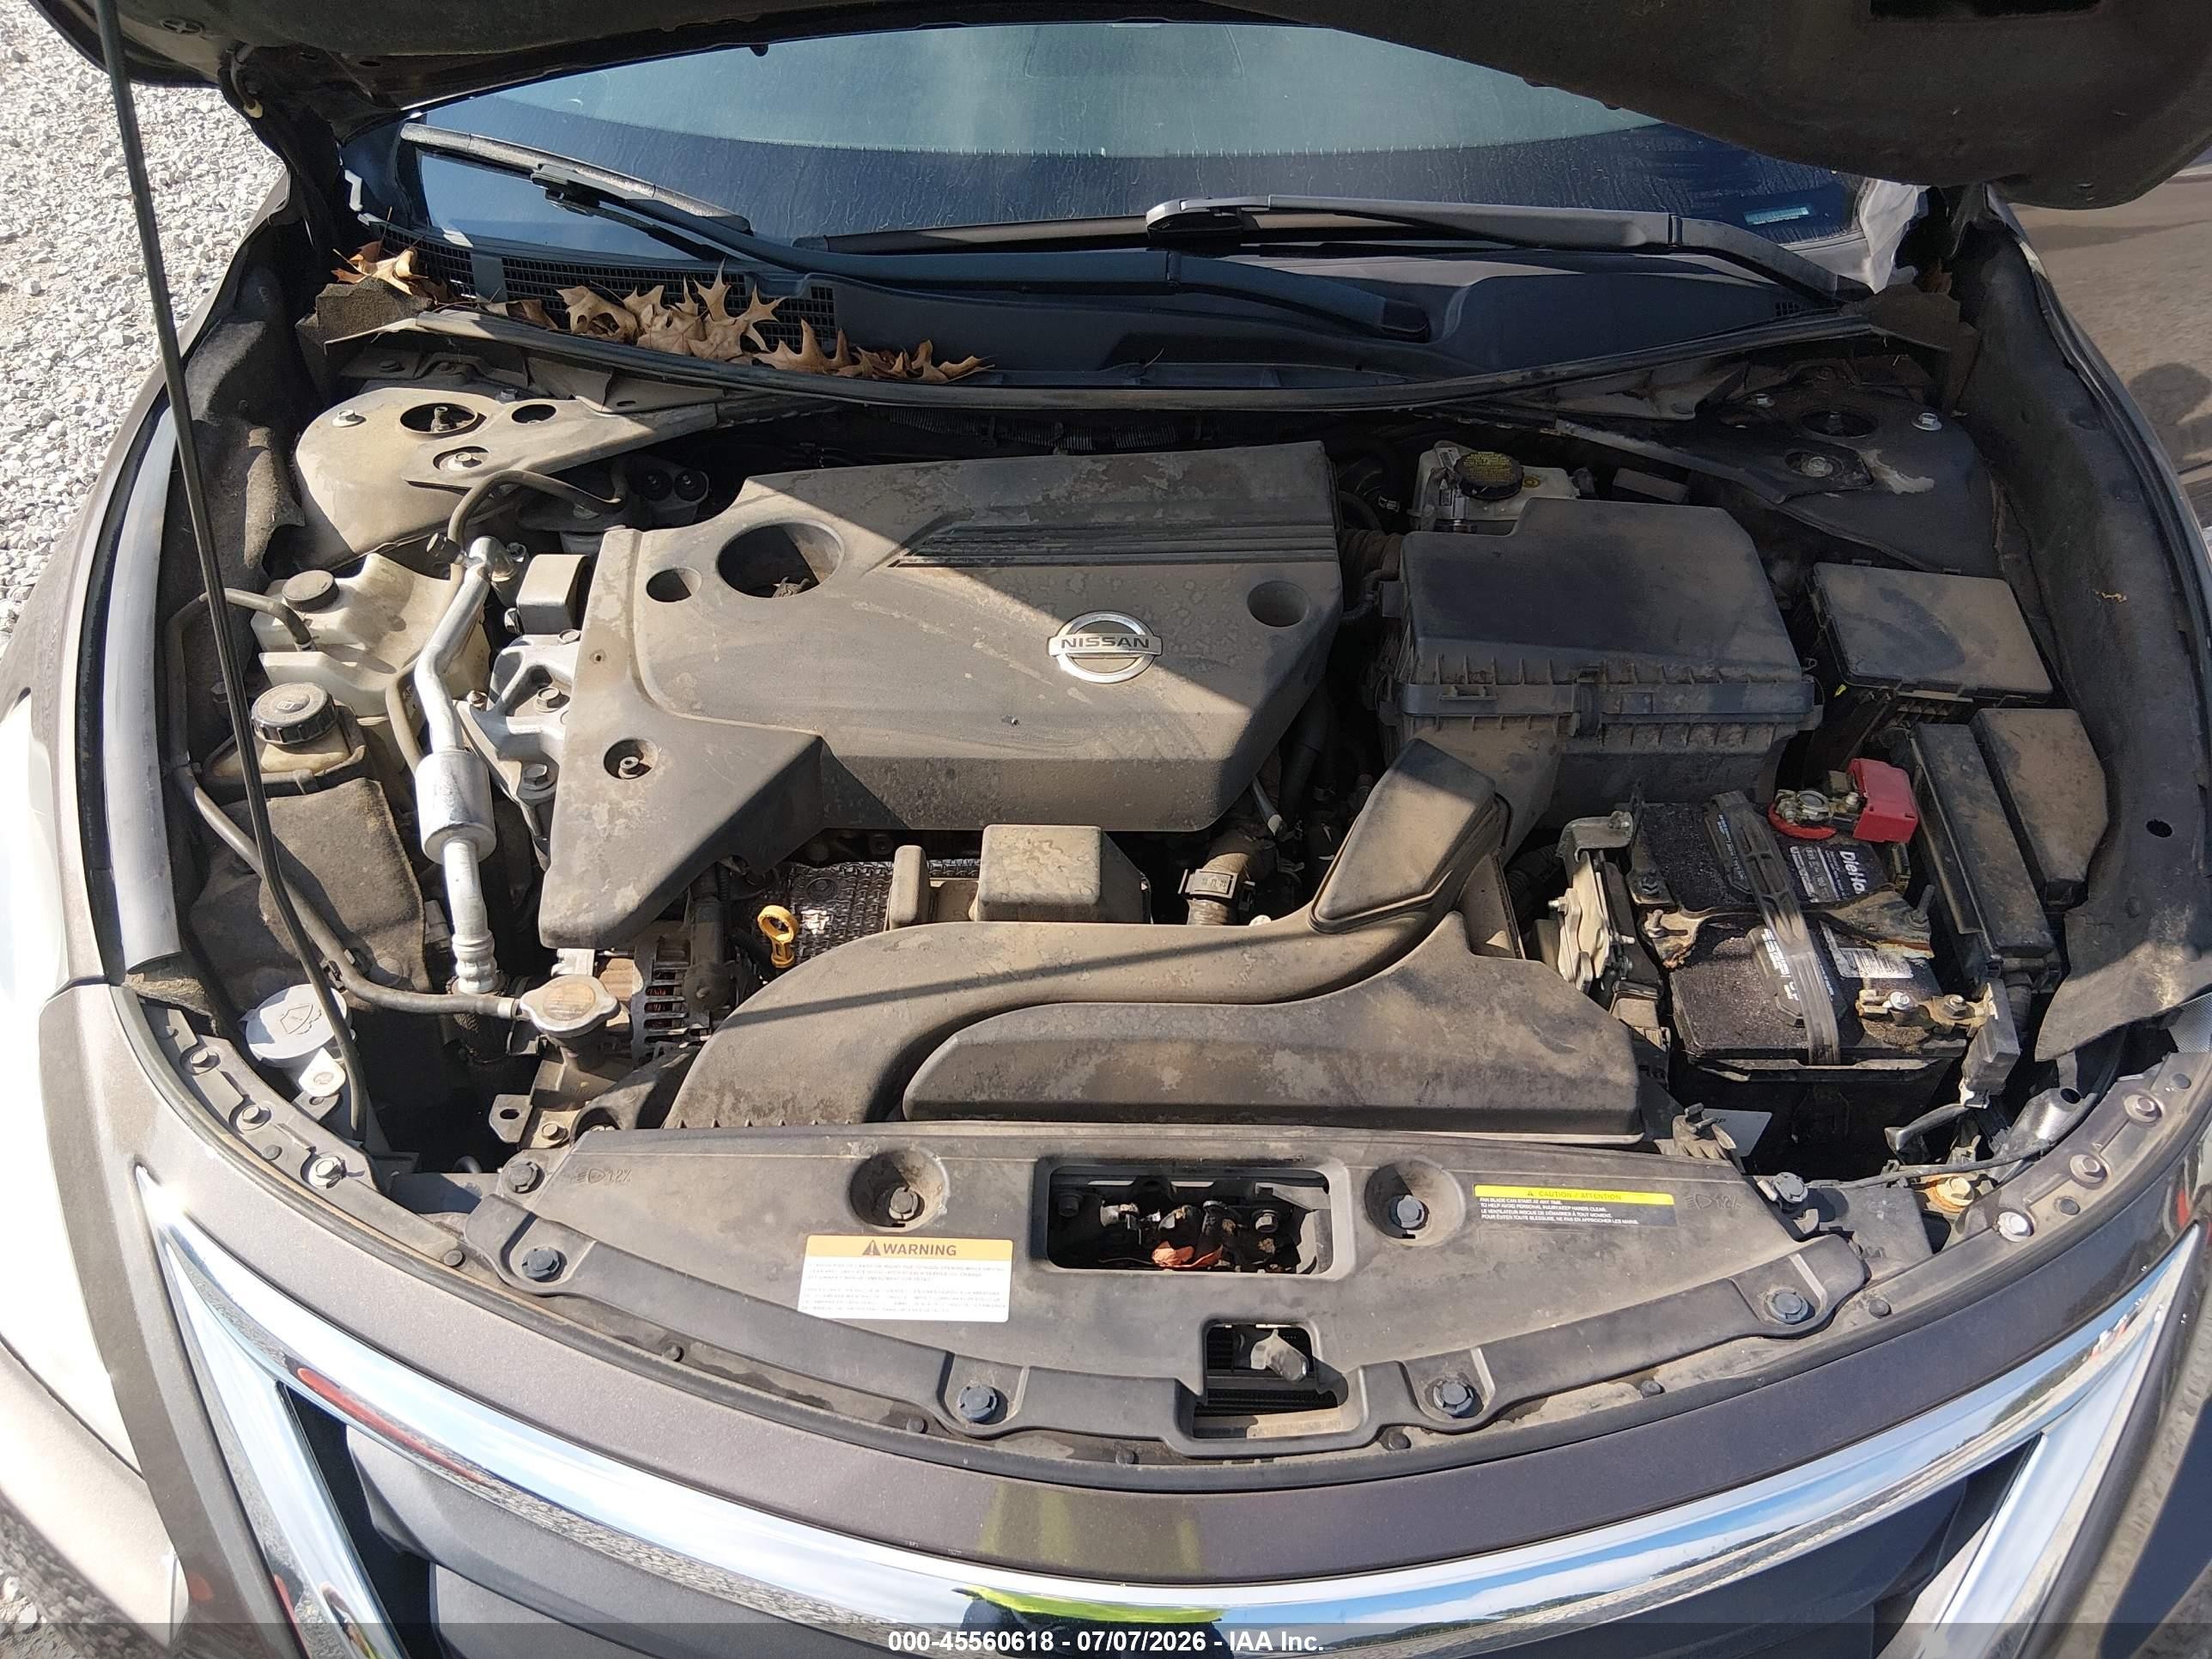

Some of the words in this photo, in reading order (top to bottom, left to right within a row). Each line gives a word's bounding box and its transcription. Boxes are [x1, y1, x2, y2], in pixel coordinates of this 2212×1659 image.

[1061, 636, 1149, 648] NISSAN
[1839, 851, 1867, 894] DieHa
[883, 1243, 957, 1256] WARNING
